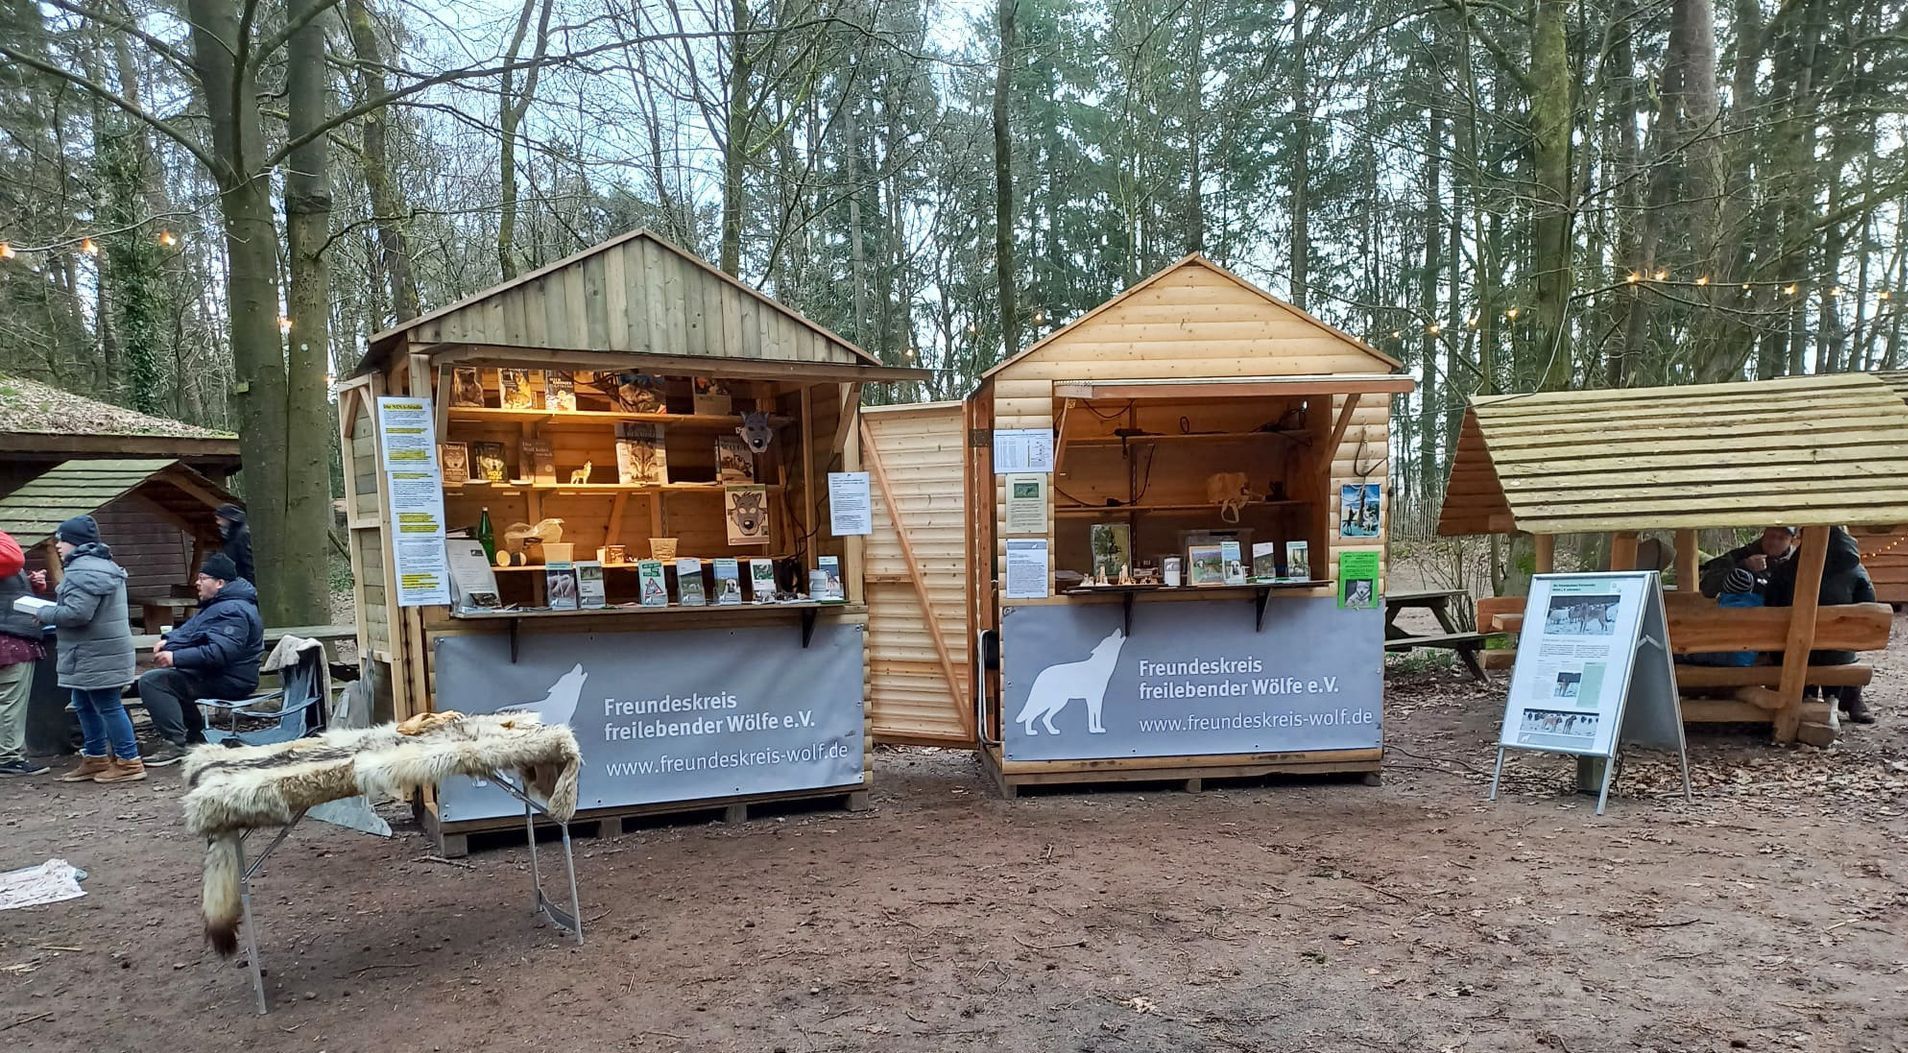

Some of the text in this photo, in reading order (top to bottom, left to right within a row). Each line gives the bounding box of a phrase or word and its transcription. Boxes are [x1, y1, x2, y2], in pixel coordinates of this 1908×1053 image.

[1139, 656, 1262, 677] Freundeskreis
[1139, 676, 1339, 700] freilebender Wölfe e.V.
[604, 691, 738, 716] Freundeskreis
[604, 710, 815, 741] freilebender Wölfe e.V.
[1139, 707, 1373, 732] www.freundeskreis-wolf.de
[606, 742, 849, 777] www.freundeskreis-wolf.de
